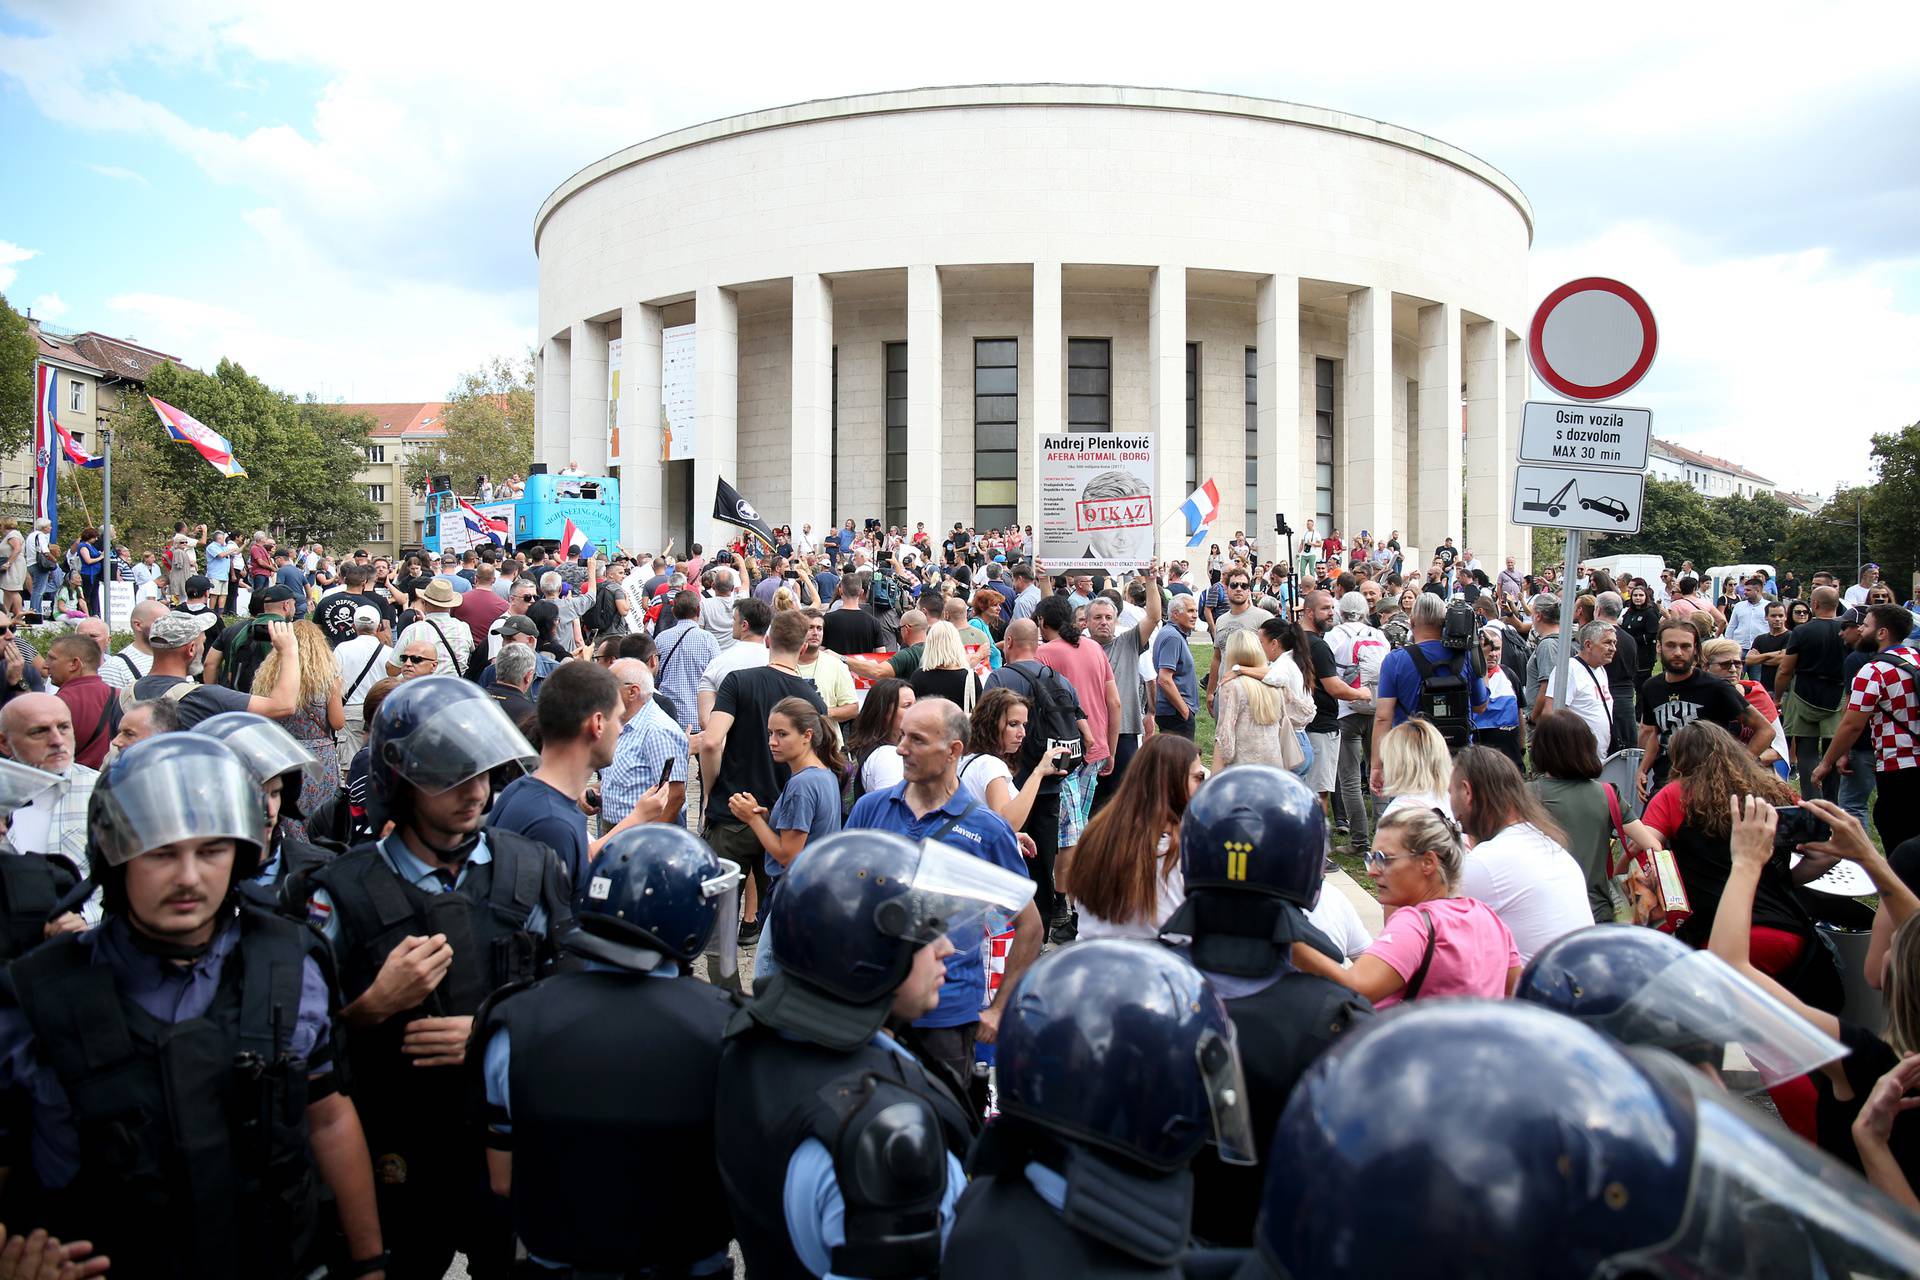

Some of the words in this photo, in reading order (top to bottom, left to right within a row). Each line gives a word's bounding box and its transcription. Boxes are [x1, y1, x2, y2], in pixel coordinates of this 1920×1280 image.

[1556, 410, 1584, 424] Osim
[1589, 413, 1624, 427] vozila
[1556, 430, 1563, 440] s
[1567, 428, 1621, 443] dozvolom
[1044, 437, 1084, 452] Andrej
[1088, 436, 1149, 449] Plenković
[1047, 452, 1075, 461] AFERA
[1077, 452, 1117, 461] HOTMAIL
[1119, 452, 1150, 462] (BORG)
[1552, 445, 1576, 458] MAX
[1581, 447, 1595, 459] 30
[1600, 448, 1621, 460] min
[1085, 504, 1145, 522] OTKAZ
